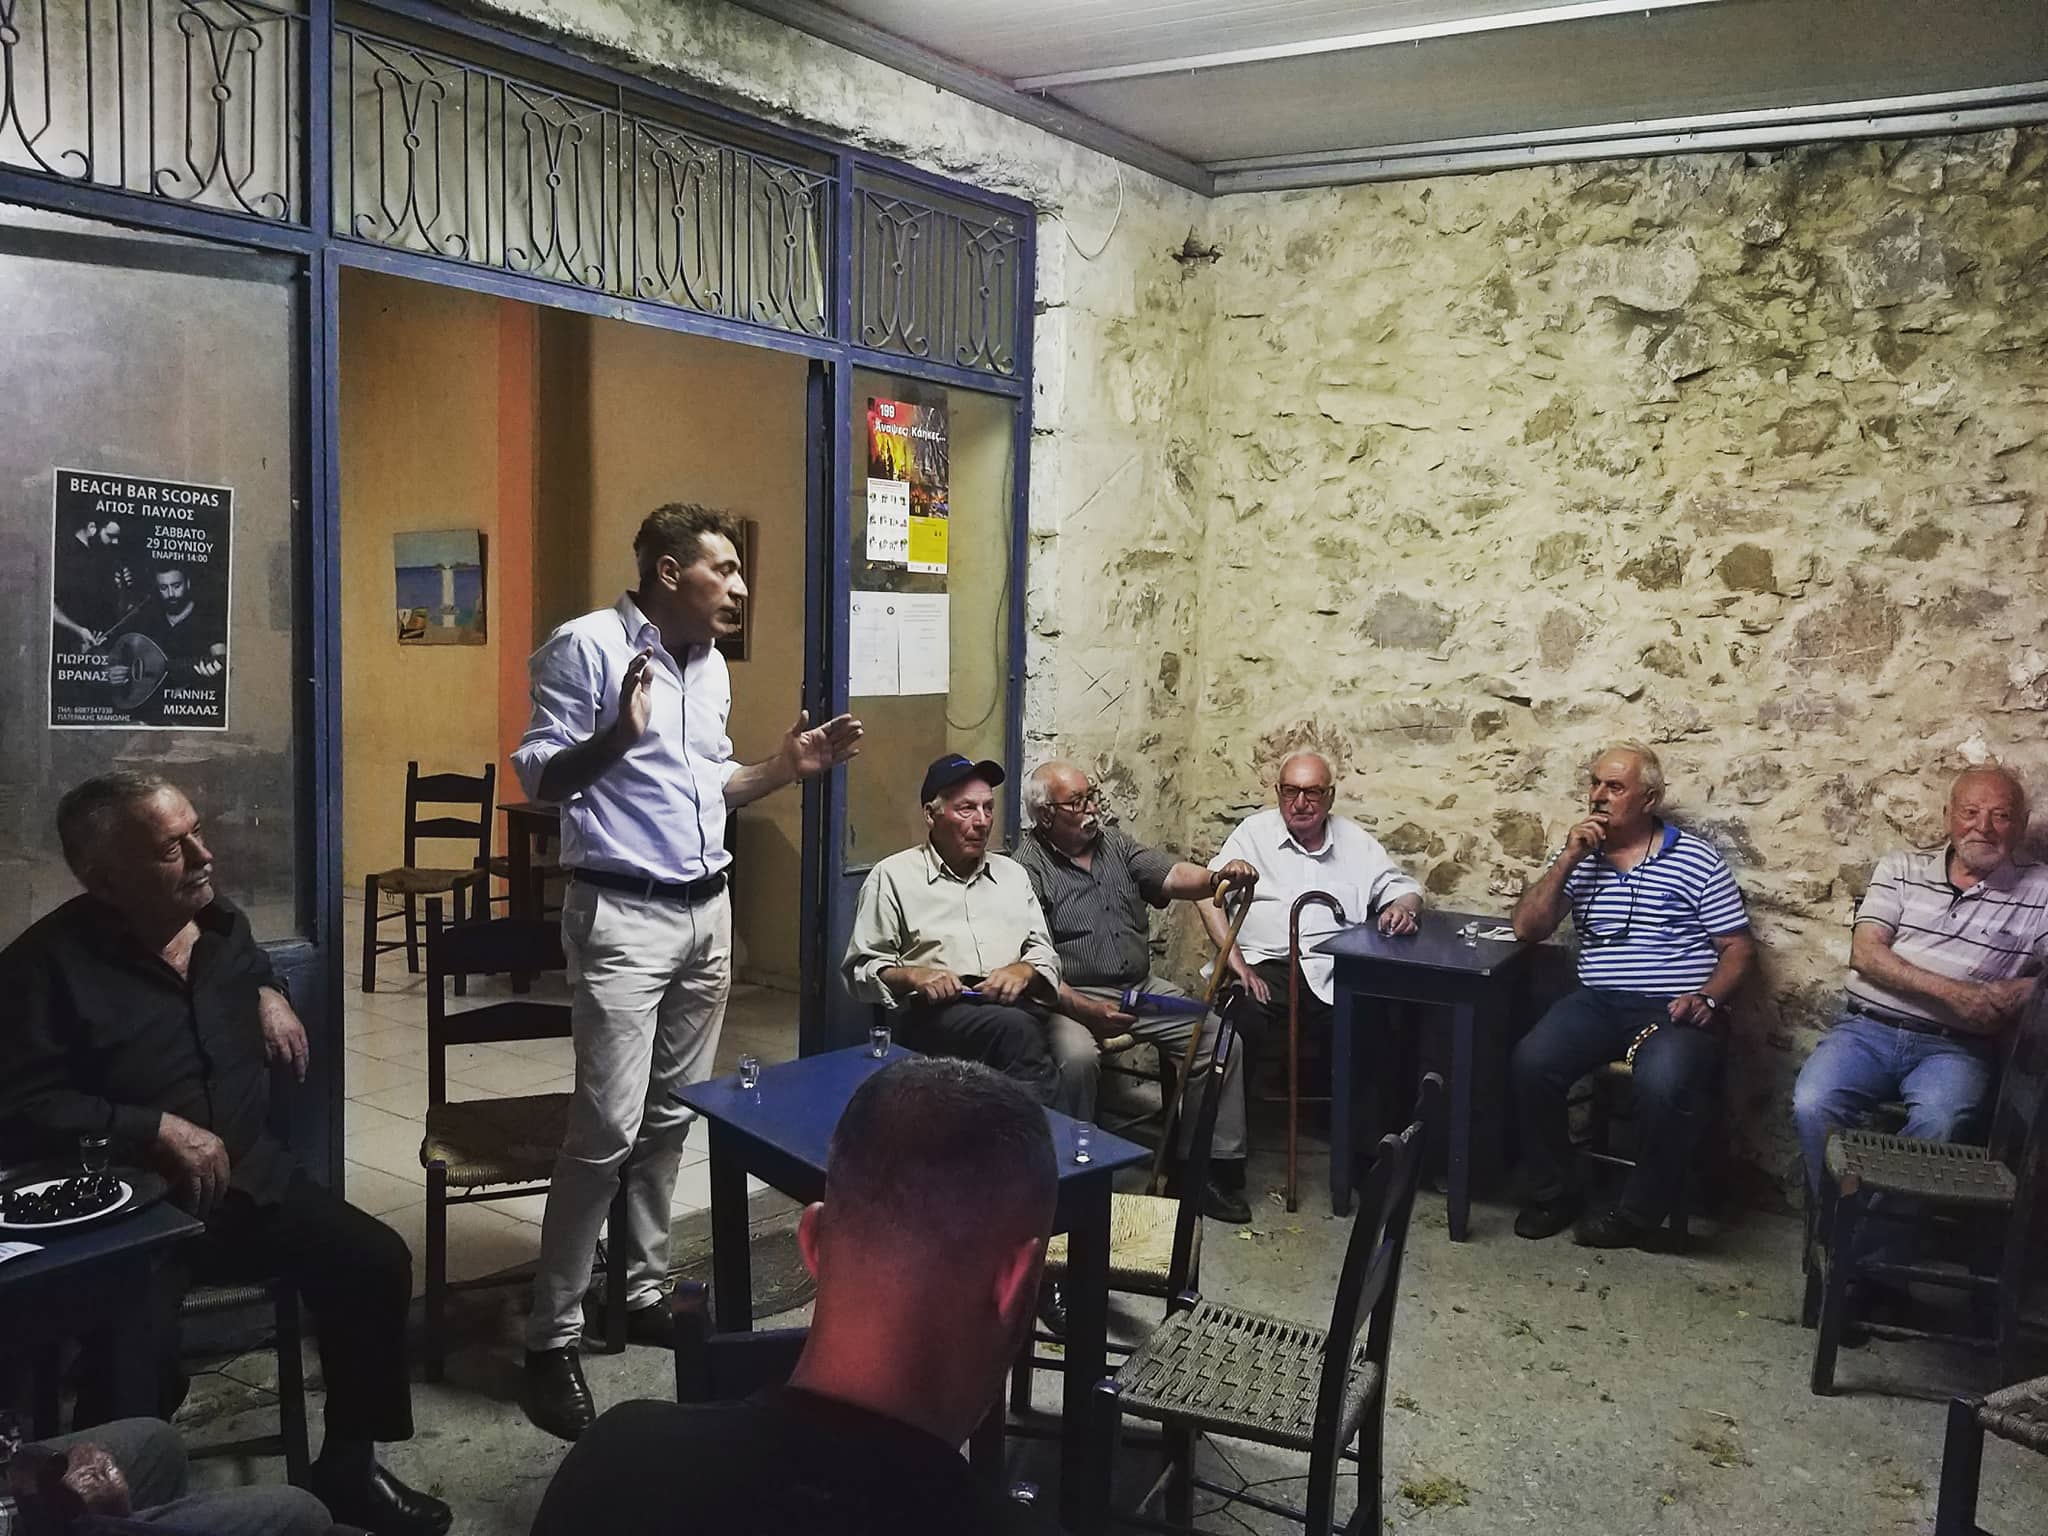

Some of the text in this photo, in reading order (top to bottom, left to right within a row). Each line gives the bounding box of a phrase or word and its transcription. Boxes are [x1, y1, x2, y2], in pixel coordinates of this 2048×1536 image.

[70, 478, 219, 507] BEACH BAR SCOPAS
[96, 500, 195, 520] ΑΓΙΟΣ ΠΑΥΛΟΣ
[154, 525, 206, 541] ΣΑΒΒΑΤΟ
[146, 538, 214, 553] 29 ΙΟΥΝΙΟΥ
[56, 653, 109, 666] ΓΙΩΡΓΟΣ
[58, 669, 109, 682] ΒΡΑΝΑΣ
[163, 689, 216, 701] ΓΙΑΝΝΗΣ
[163, 704, 219, 716] ΜΙΧΑΛΑΣ
